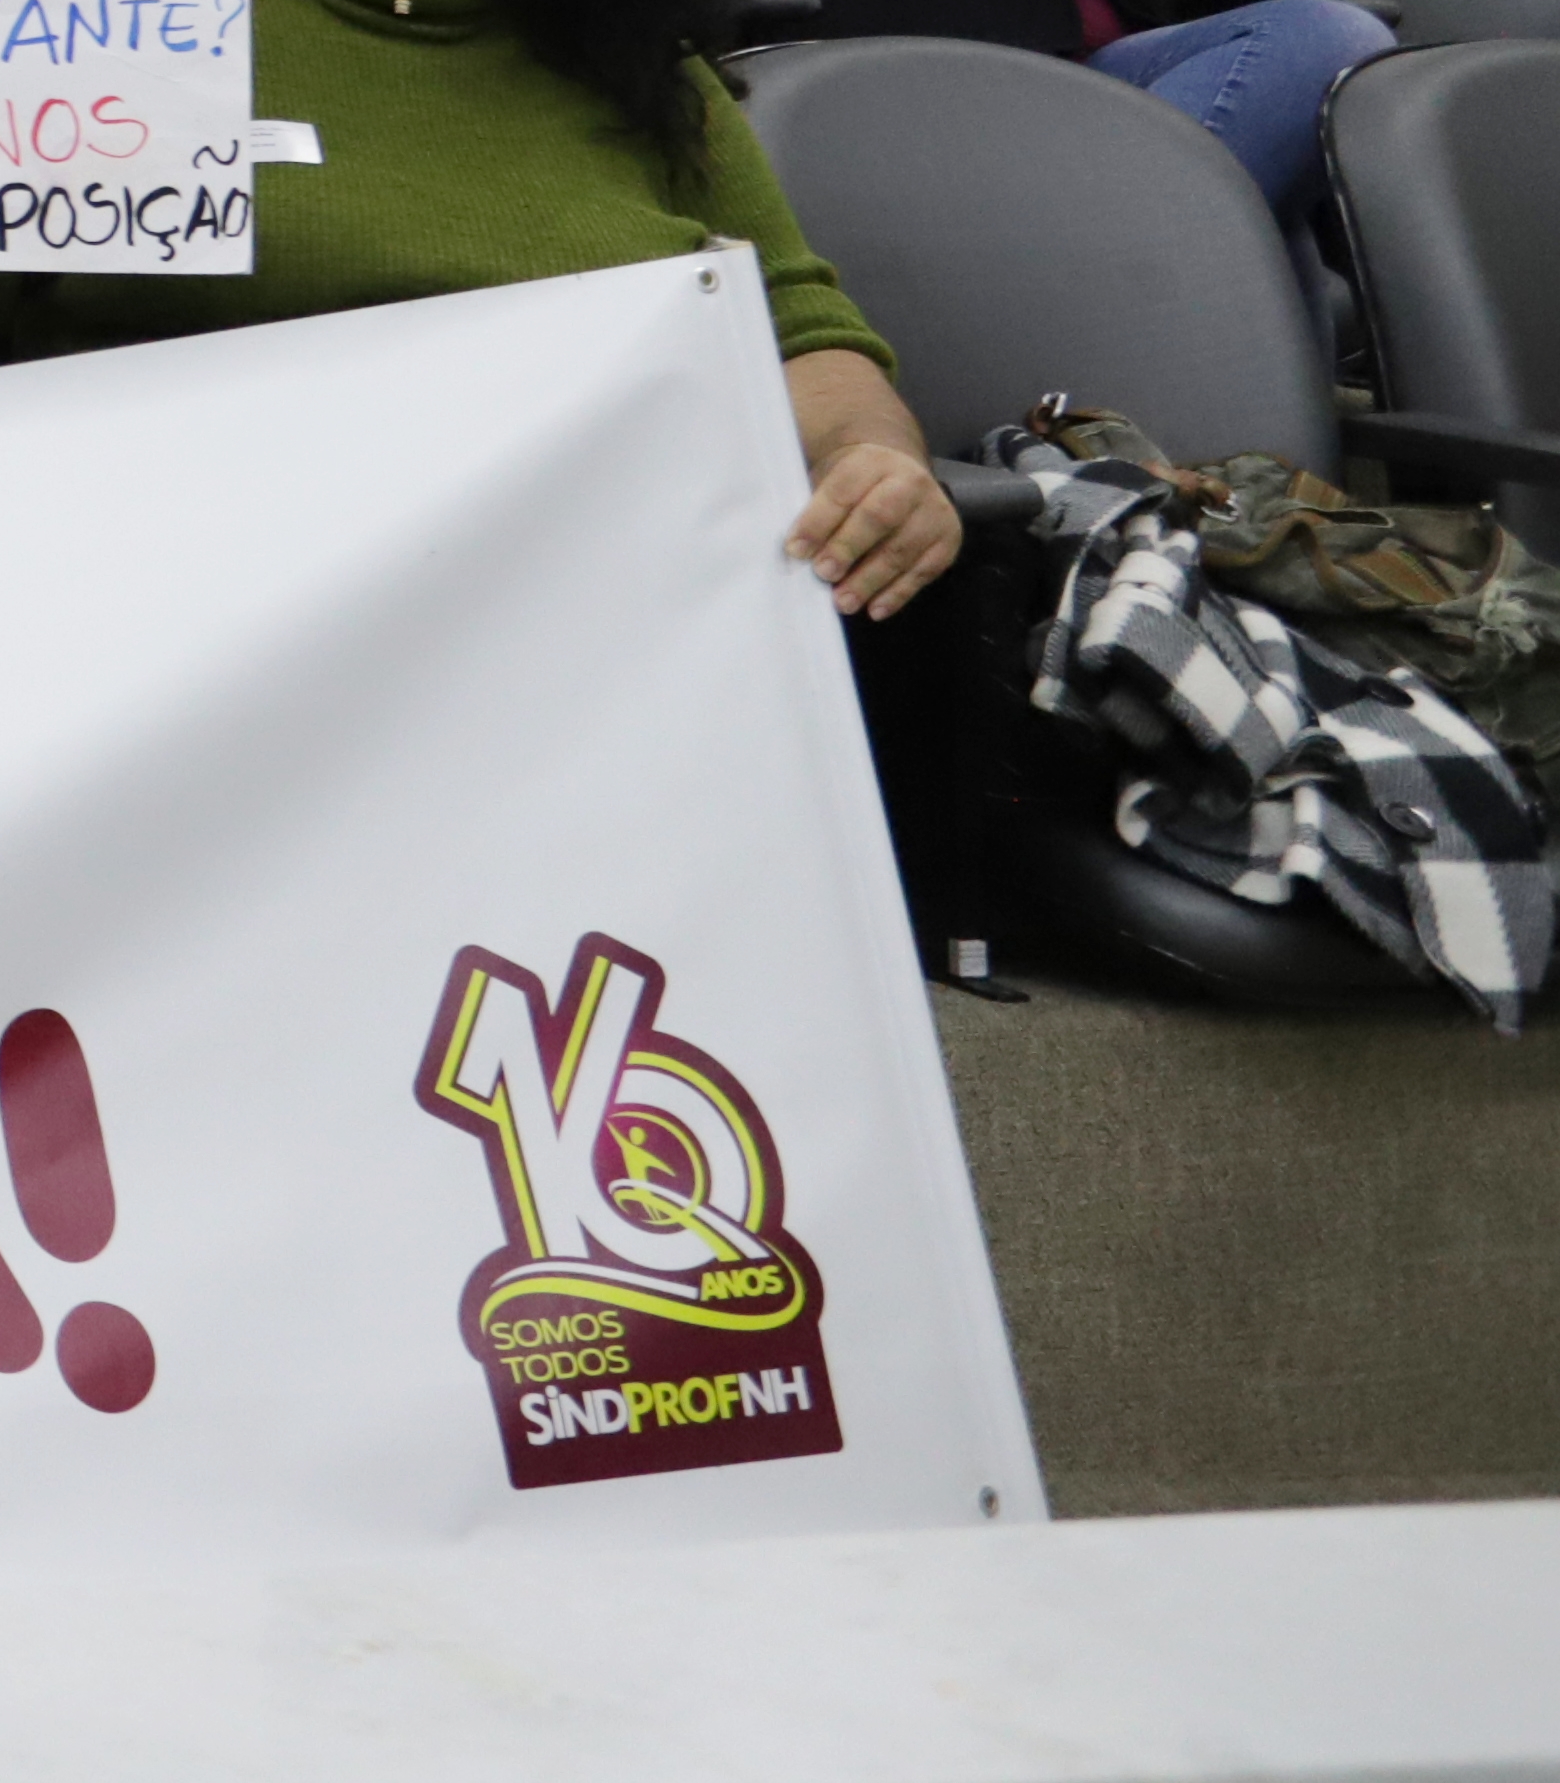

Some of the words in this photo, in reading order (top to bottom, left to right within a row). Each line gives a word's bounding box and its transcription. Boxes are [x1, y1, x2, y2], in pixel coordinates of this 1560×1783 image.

[700, 1264, 785, 1302] ANOS
[490, 1310, 625, 1351] SOMOS
[499, 1345, 631, 1384] TODOS
